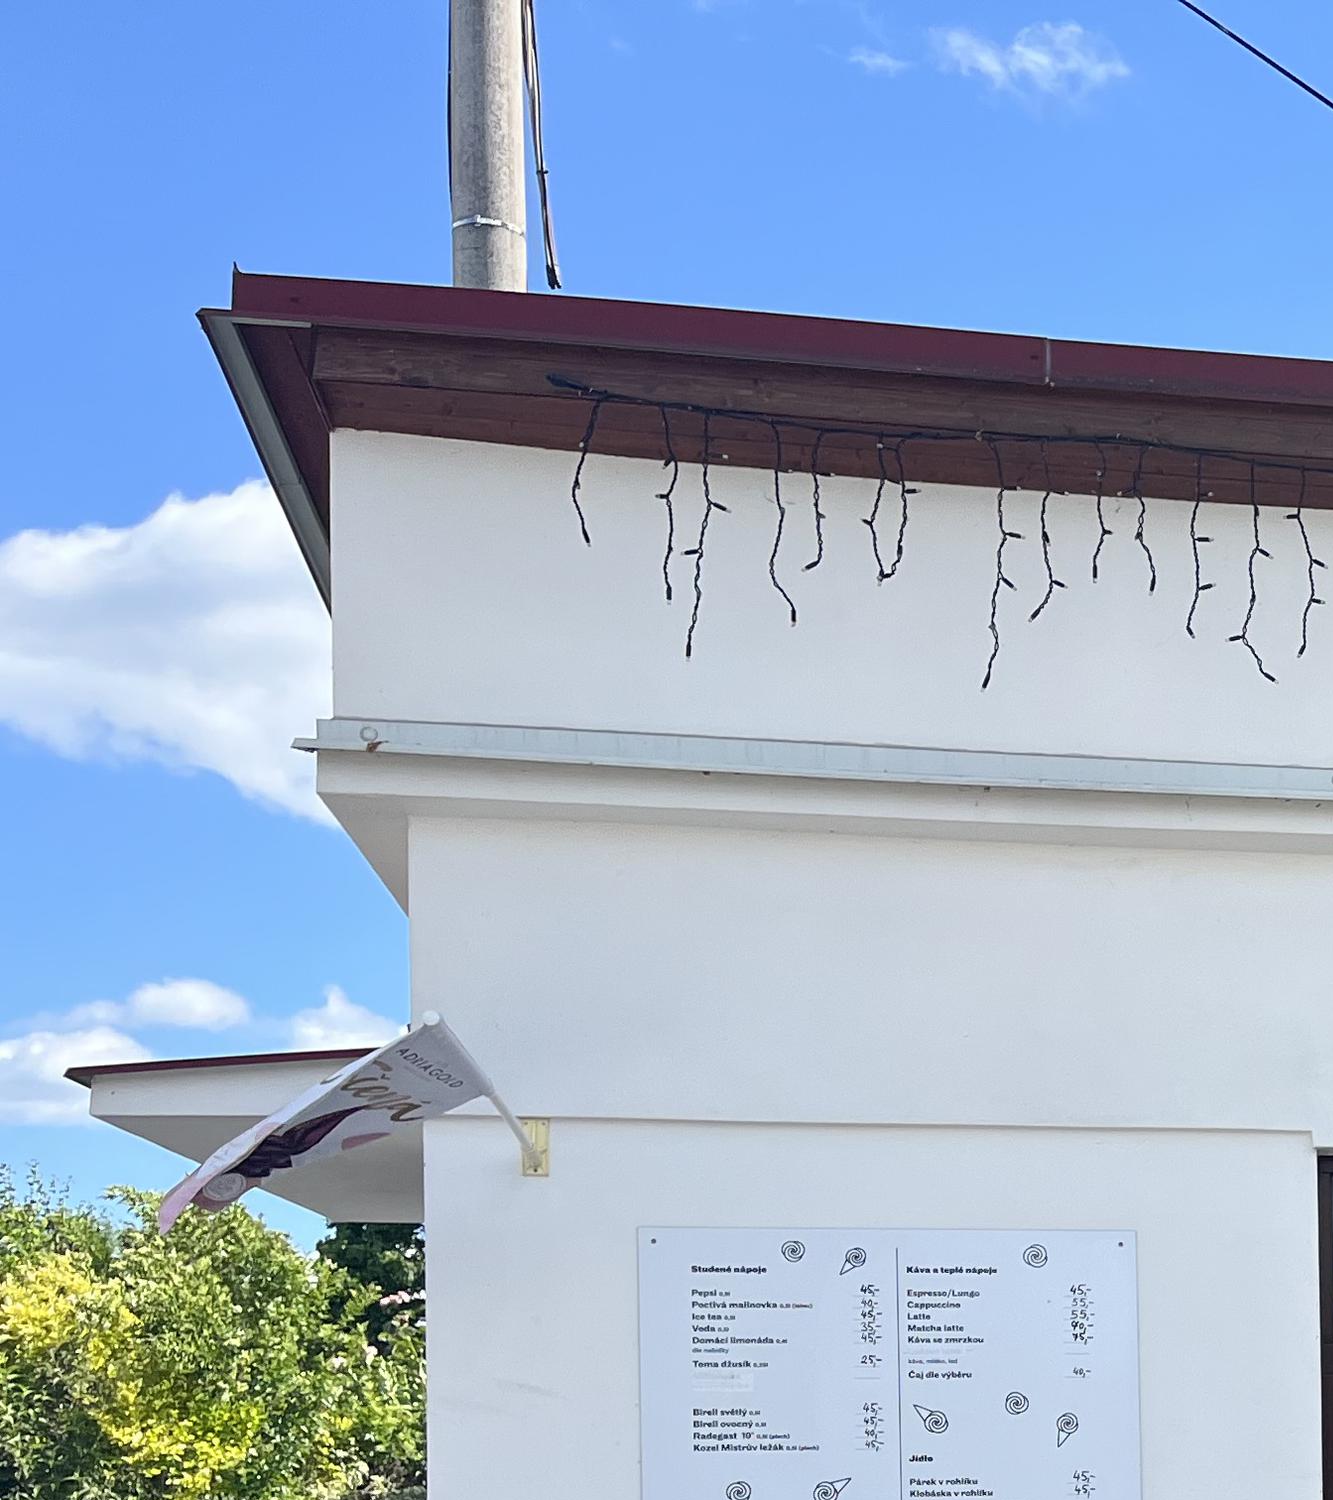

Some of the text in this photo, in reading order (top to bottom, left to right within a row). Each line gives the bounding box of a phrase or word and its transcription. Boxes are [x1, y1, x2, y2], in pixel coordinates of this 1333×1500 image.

[691, 1265, 767, 1274] Studené nápoje
[940, 1267, 963, 1275] teplé
[965, 1267, 997, 1275] nápoje
[691, 1289, 717, 1297] Pepsi
[907, 1290, 980, 1298] Espresso/Lungo
[692, 1301, 727, 1309] Poctivá
[692, 1336, 728, 1344] Domácí
[693, 1360, 751, 1368] Toma džusík
[908, 1371, 972, 1379] Čaj dle výběru
[720, 1408, 746, 1417] světlý
[720, 1420, 753, 1428] ovocný
[693, 1432, 737, 1441] Radegast
[693, 1444, 719, 1452] Kozel
